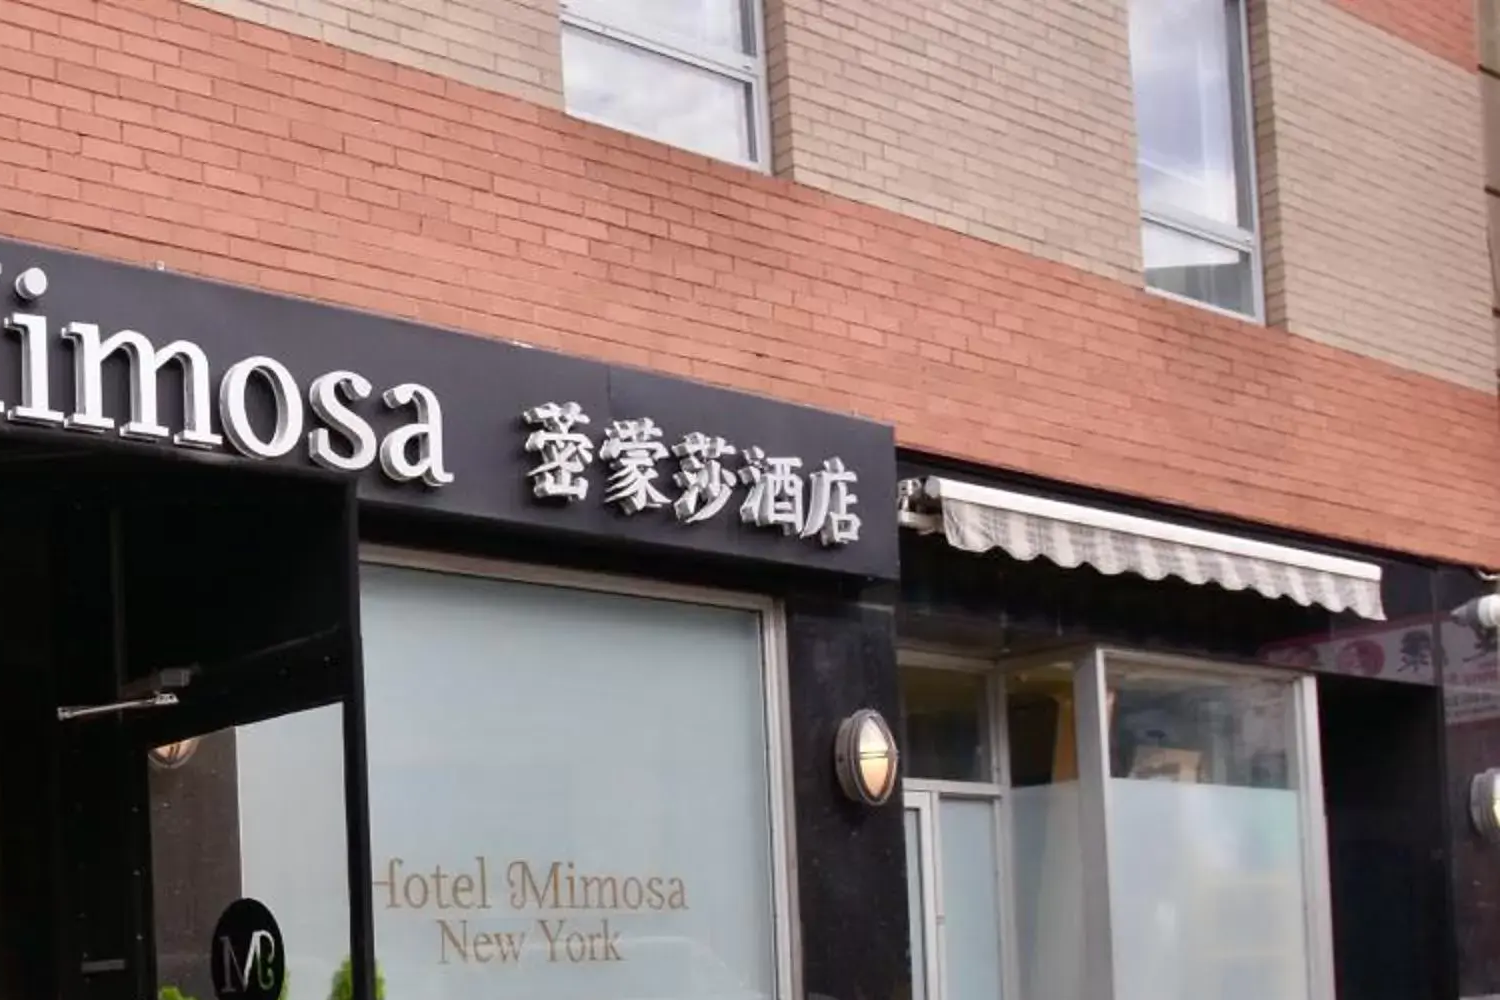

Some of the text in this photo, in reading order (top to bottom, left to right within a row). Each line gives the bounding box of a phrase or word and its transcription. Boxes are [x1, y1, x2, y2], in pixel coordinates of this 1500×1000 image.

[507, 861, 689, 909] Mimosa
[436, 918, 623, 964] New York
